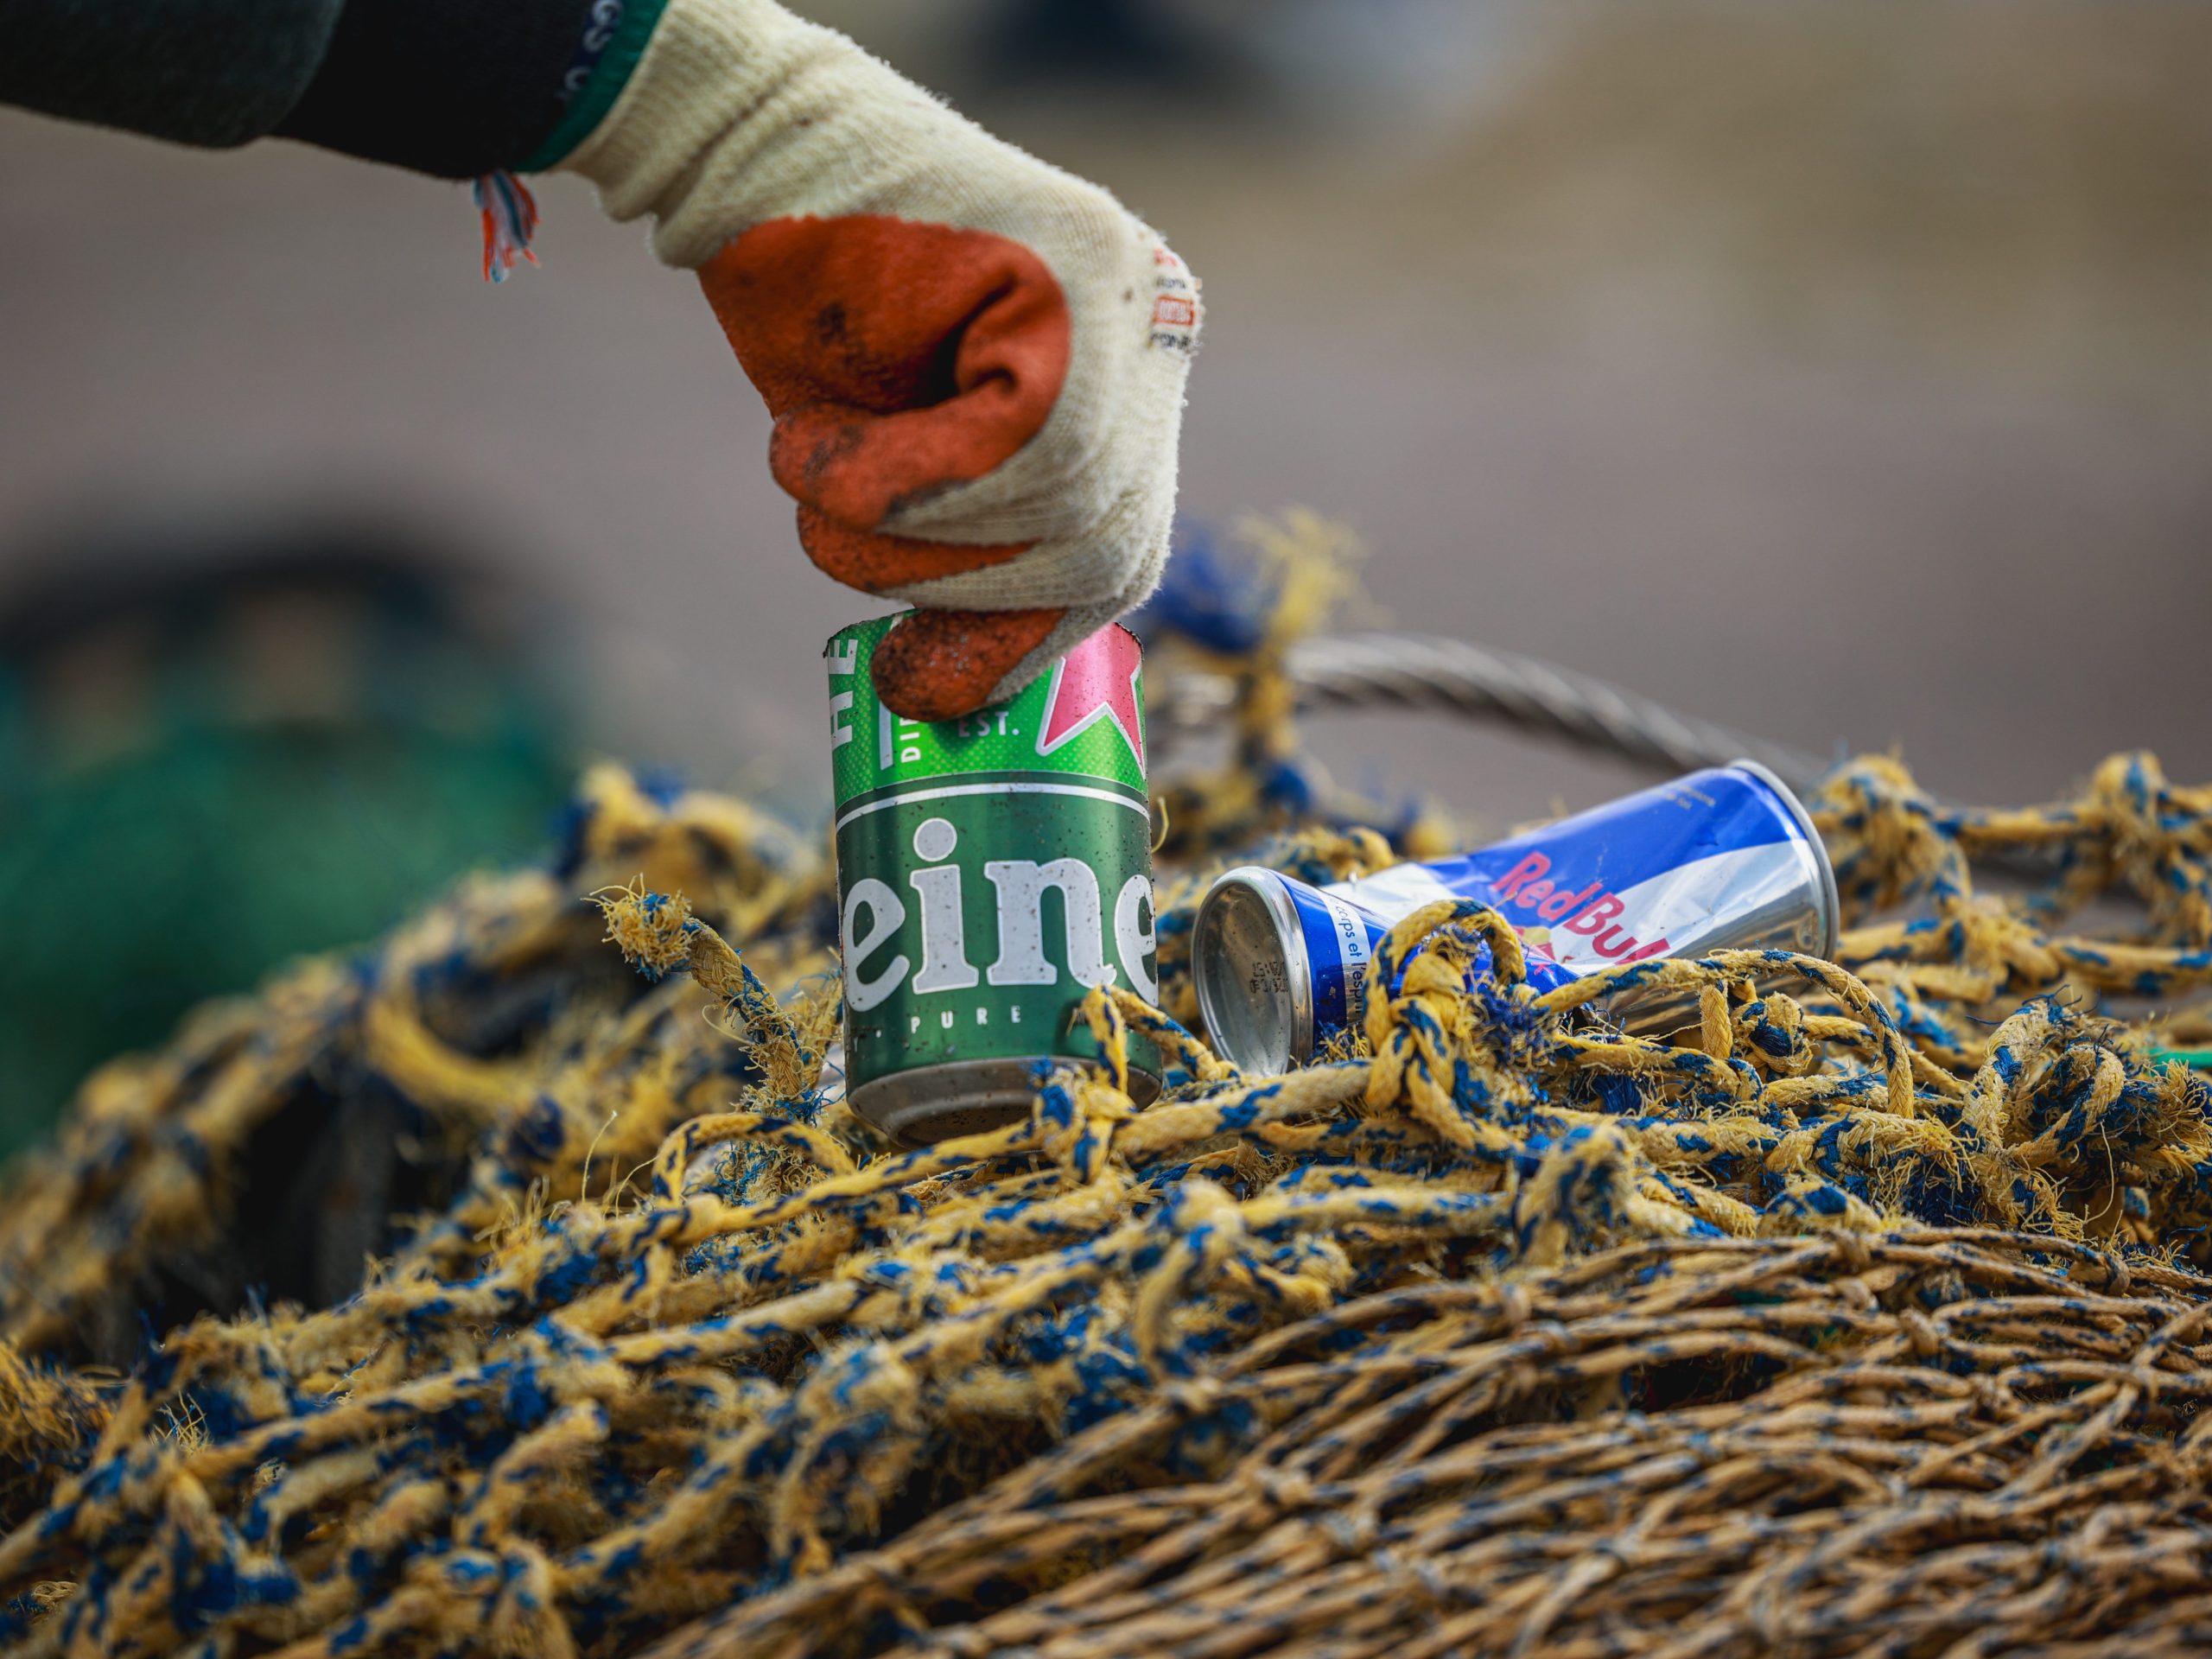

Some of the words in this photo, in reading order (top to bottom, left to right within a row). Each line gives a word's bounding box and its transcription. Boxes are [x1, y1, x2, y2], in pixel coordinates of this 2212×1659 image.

[957, 710, 1020, 737] EST.
[1493, 851, 1604, 922] Red
[1563, 891, 1673, 966] Bul
[1335, 905, 1356, 938] corps
[1348, 942, 1363, 957] et
[910, 1005, 1021, 1034] PURE
